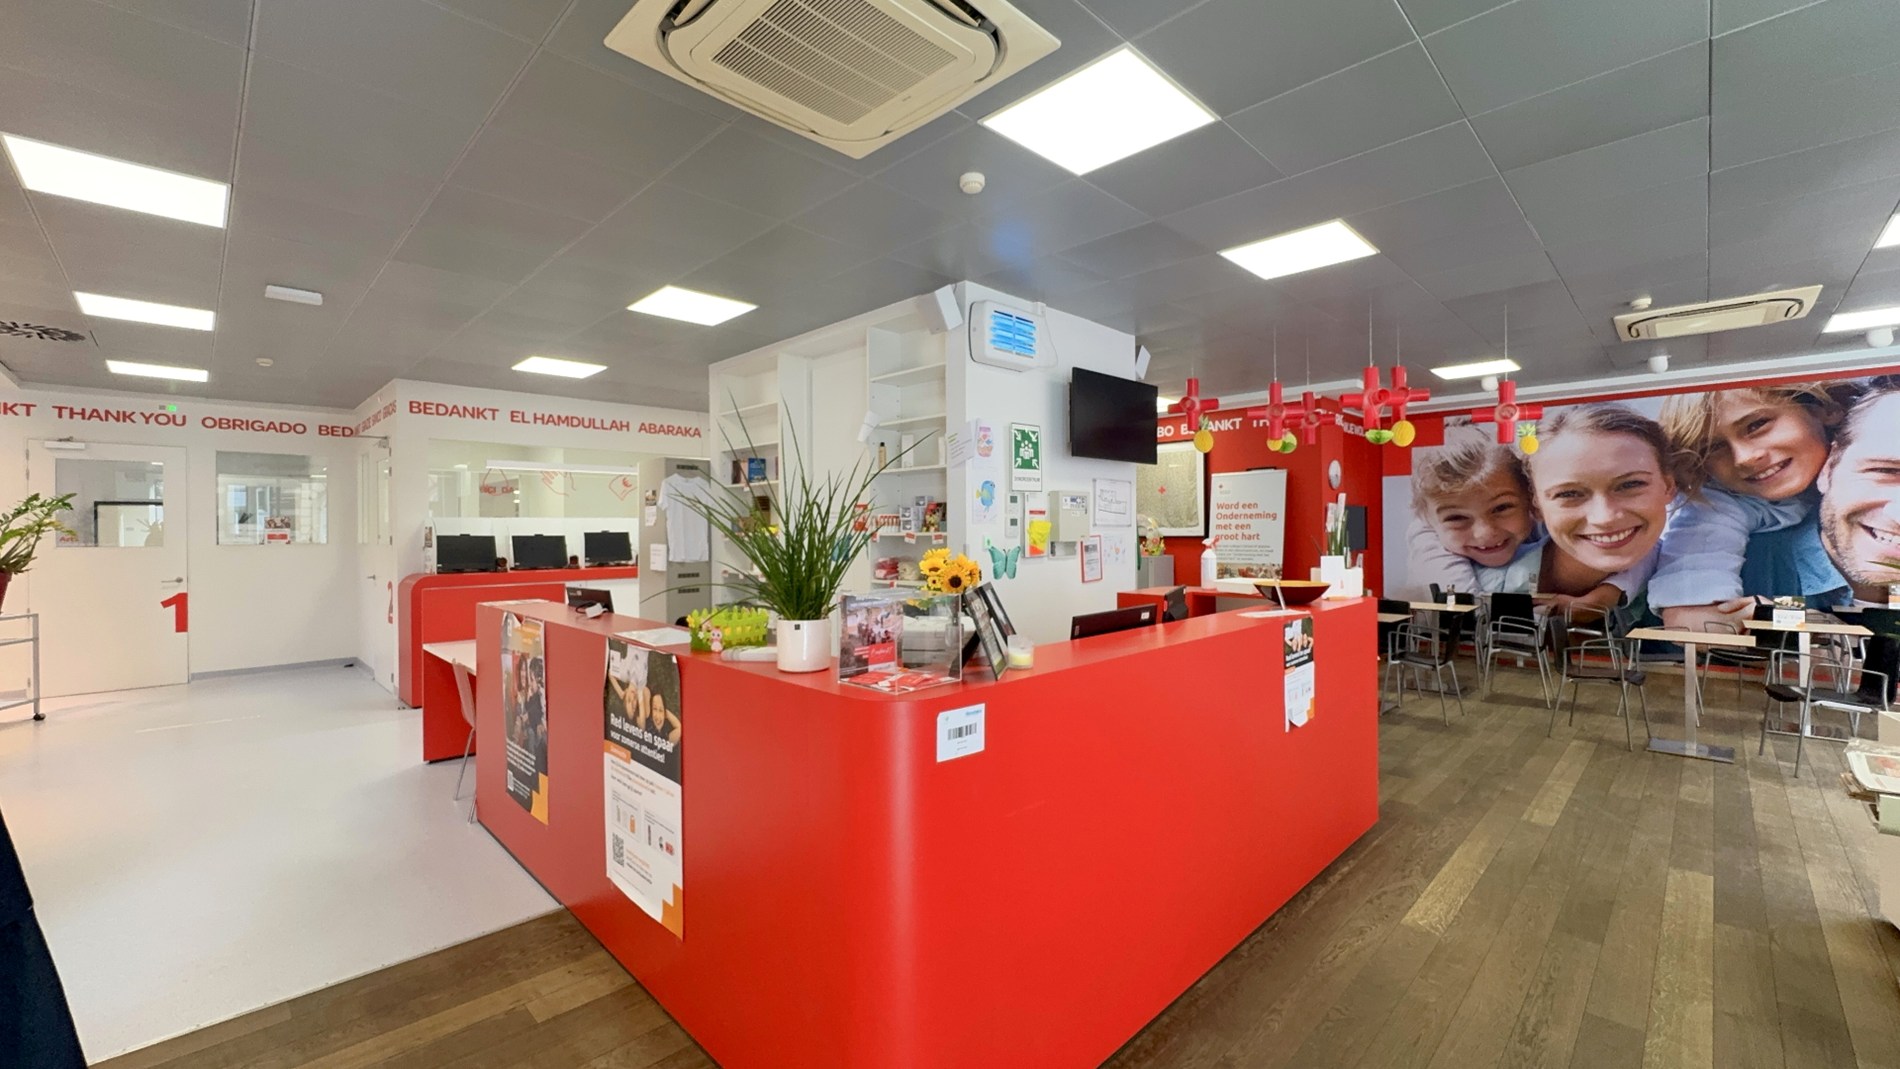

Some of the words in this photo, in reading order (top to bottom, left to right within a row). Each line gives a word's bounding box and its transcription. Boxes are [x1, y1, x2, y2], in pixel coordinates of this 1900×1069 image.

[52, 405, 136, 424] THANK
[140, 411, 187, 427] YOU
[201, 416, 307, 434] OBRIGADO
[408, 400, 499, 421] BEDANKT
[510, 411, 530, 424] EL
[533, 413, 630, 432] HAMDULLAH
[638, 422, 702, 438] ABARAKA
[1215, 510, 1278, 521] Onderneming
[1216, 502, 1239, 510] Word
[1241, 502, 1258, 510] een
[1241, 532, 1261, 541] hart
[160, 592, 188, 633] 1
[387, 580, 394, 624] 2
[610, 713, 622, 729] Red
[622, 717, 643, 739] levens
[643, 730, 653, 743] en
[653, 735, 674, 753] spaar
